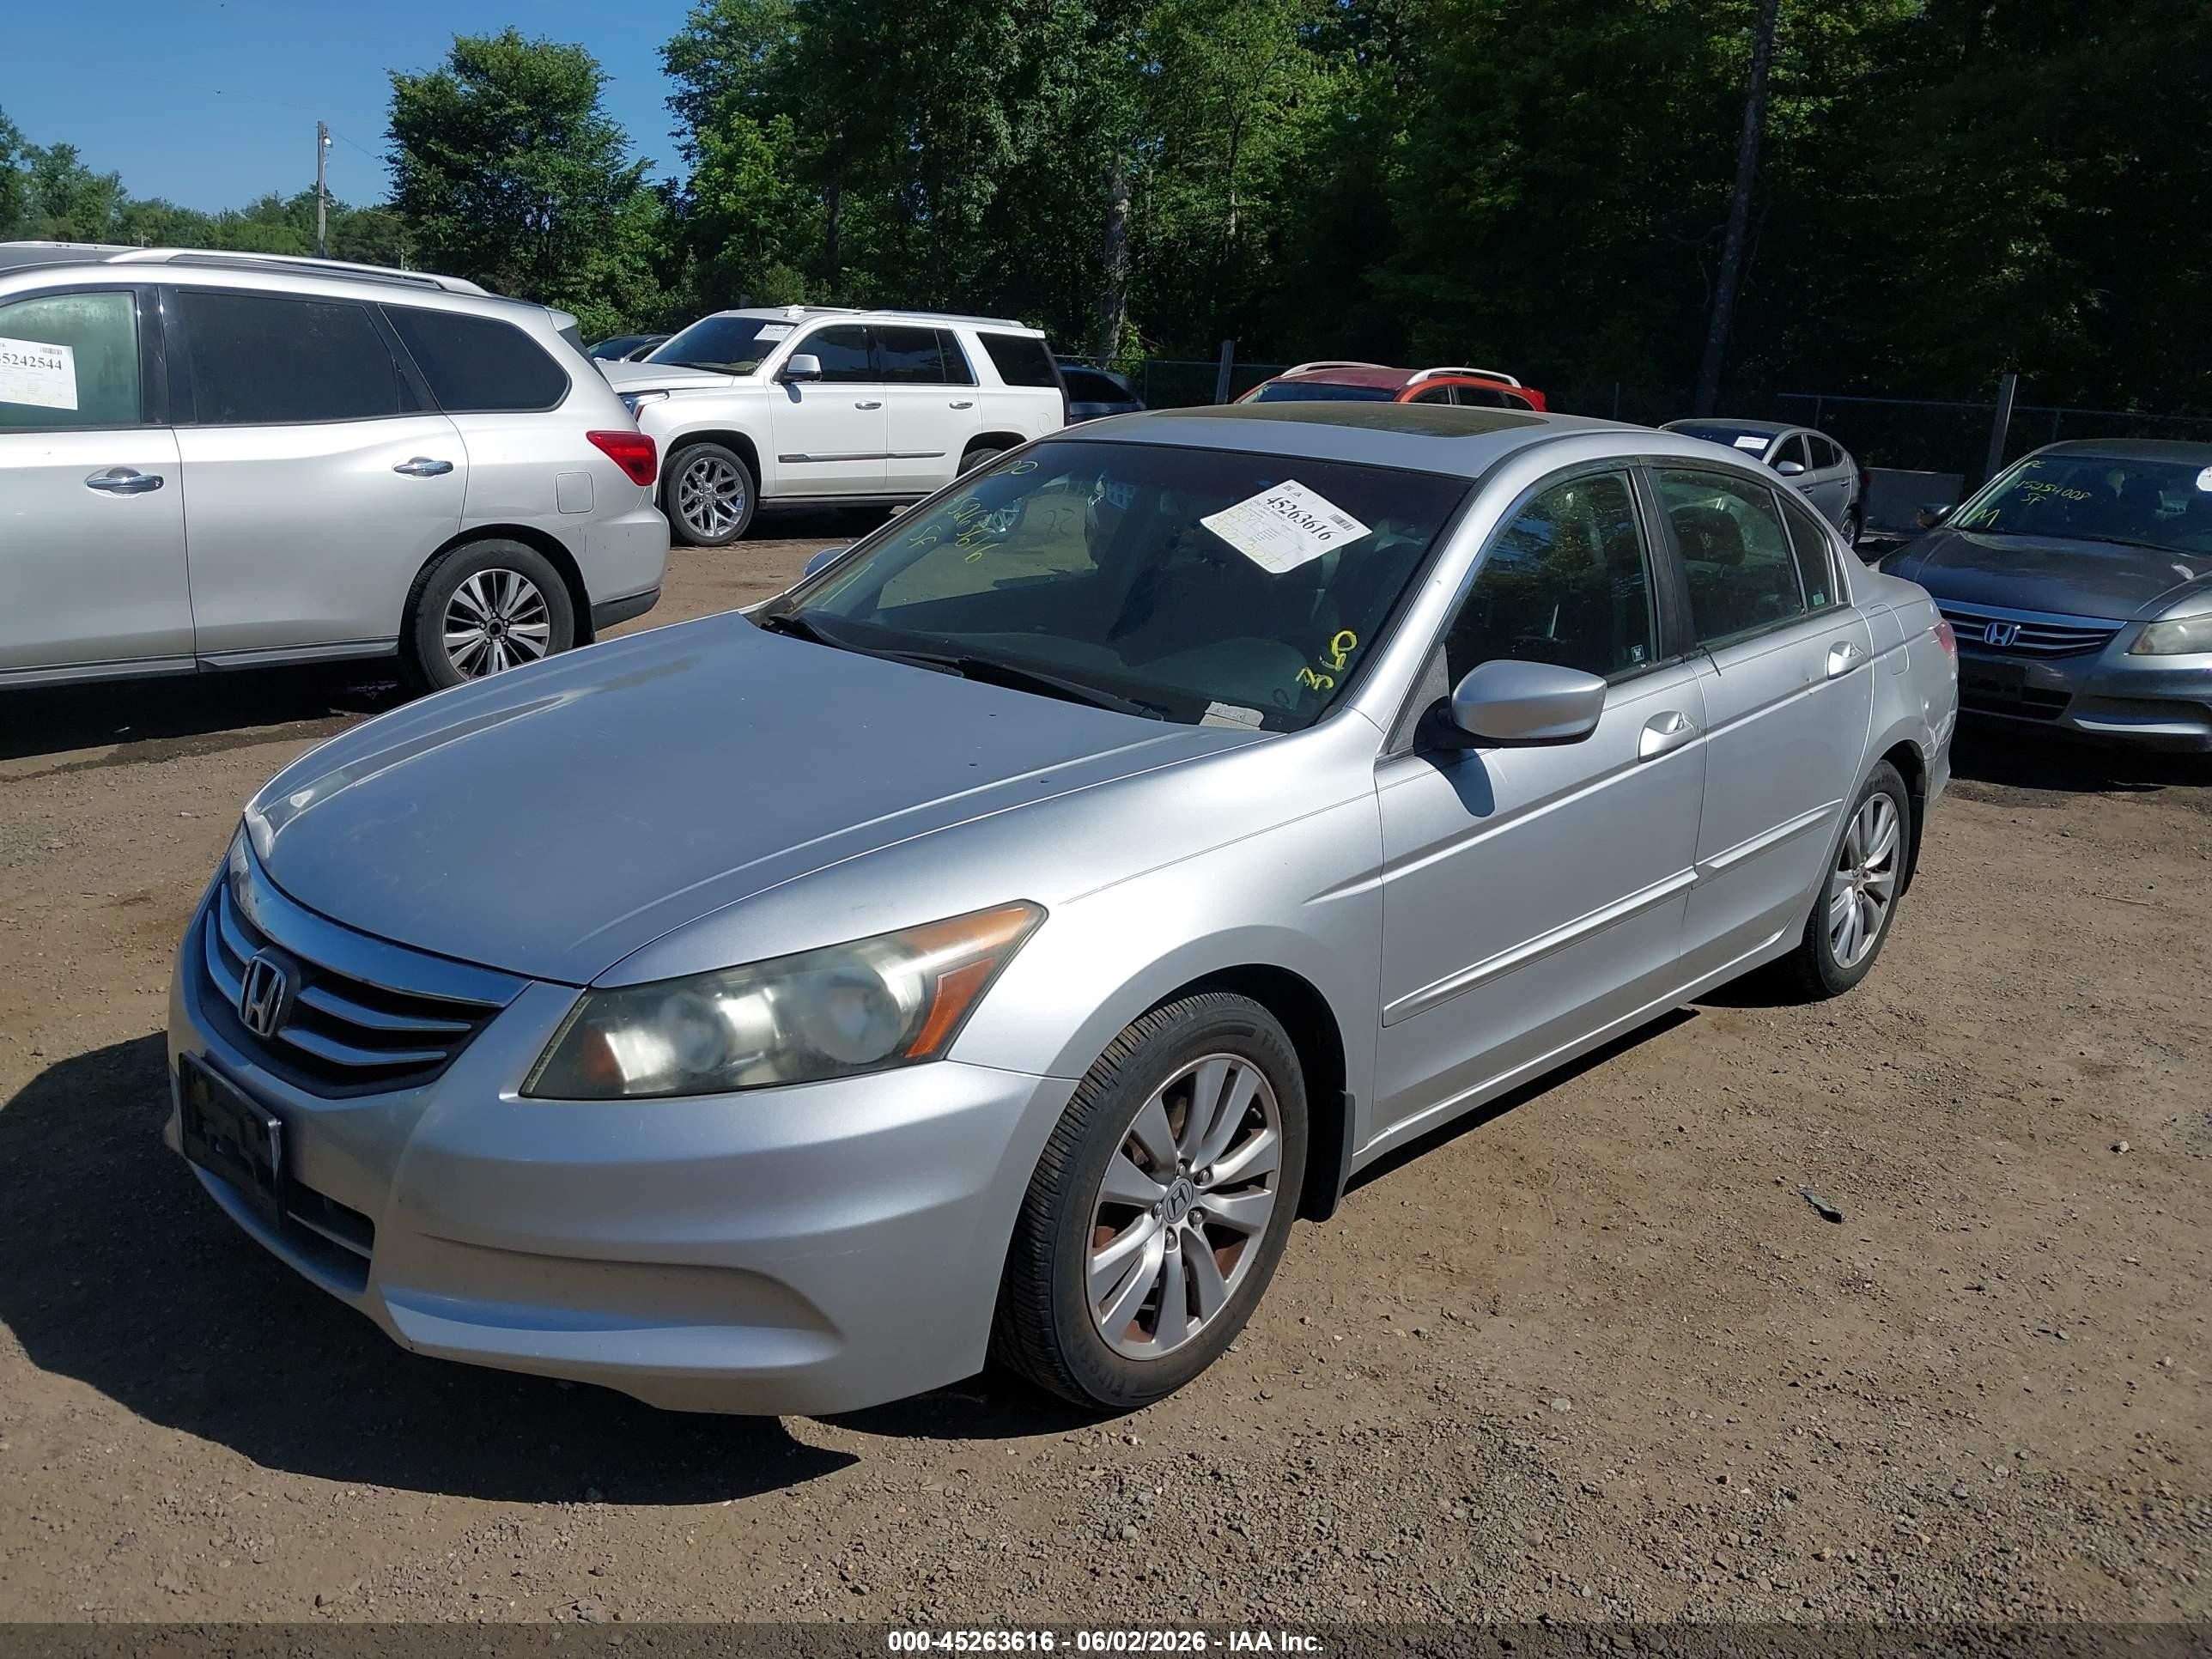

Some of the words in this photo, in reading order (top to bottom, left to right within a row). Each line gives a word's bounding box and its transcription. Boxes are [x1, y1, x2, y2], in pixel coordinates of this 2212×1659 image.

[0, 352, 63, 370] 5242544
[1267, 495, 1338, 541] 45263616
[1296, 629, 1357, 690] 360
